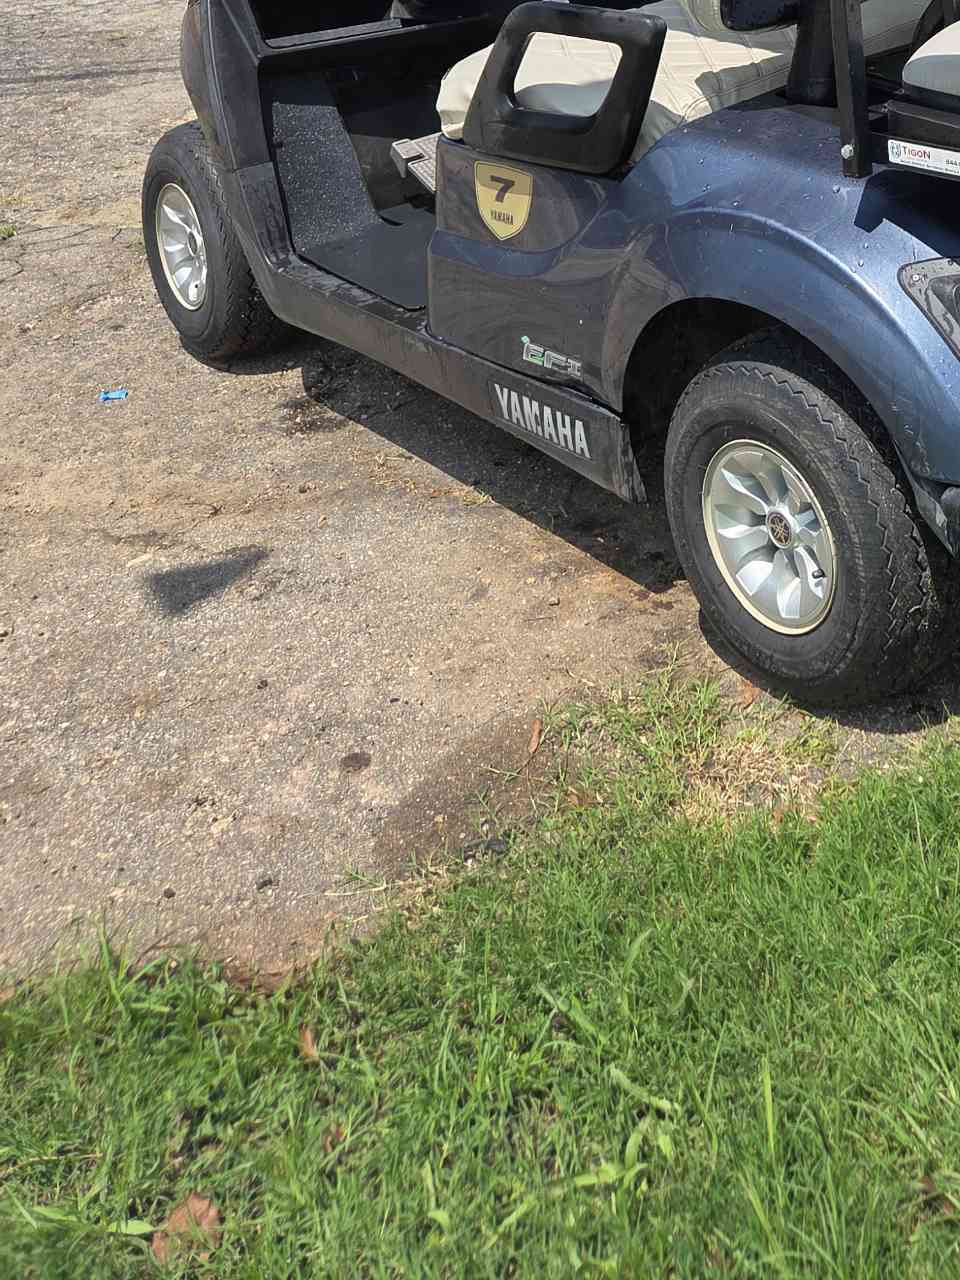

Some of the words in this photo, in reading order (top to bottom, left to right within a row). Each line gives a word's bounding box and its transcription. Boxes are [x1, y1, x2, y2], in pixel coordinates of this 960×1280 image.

[902, 145, 931, 160] TIGON
[490, 175, 516, 203] 7
[490, 209, 514, 226] YAMAHA
[494, 383, 592, 459] YAMAHA
